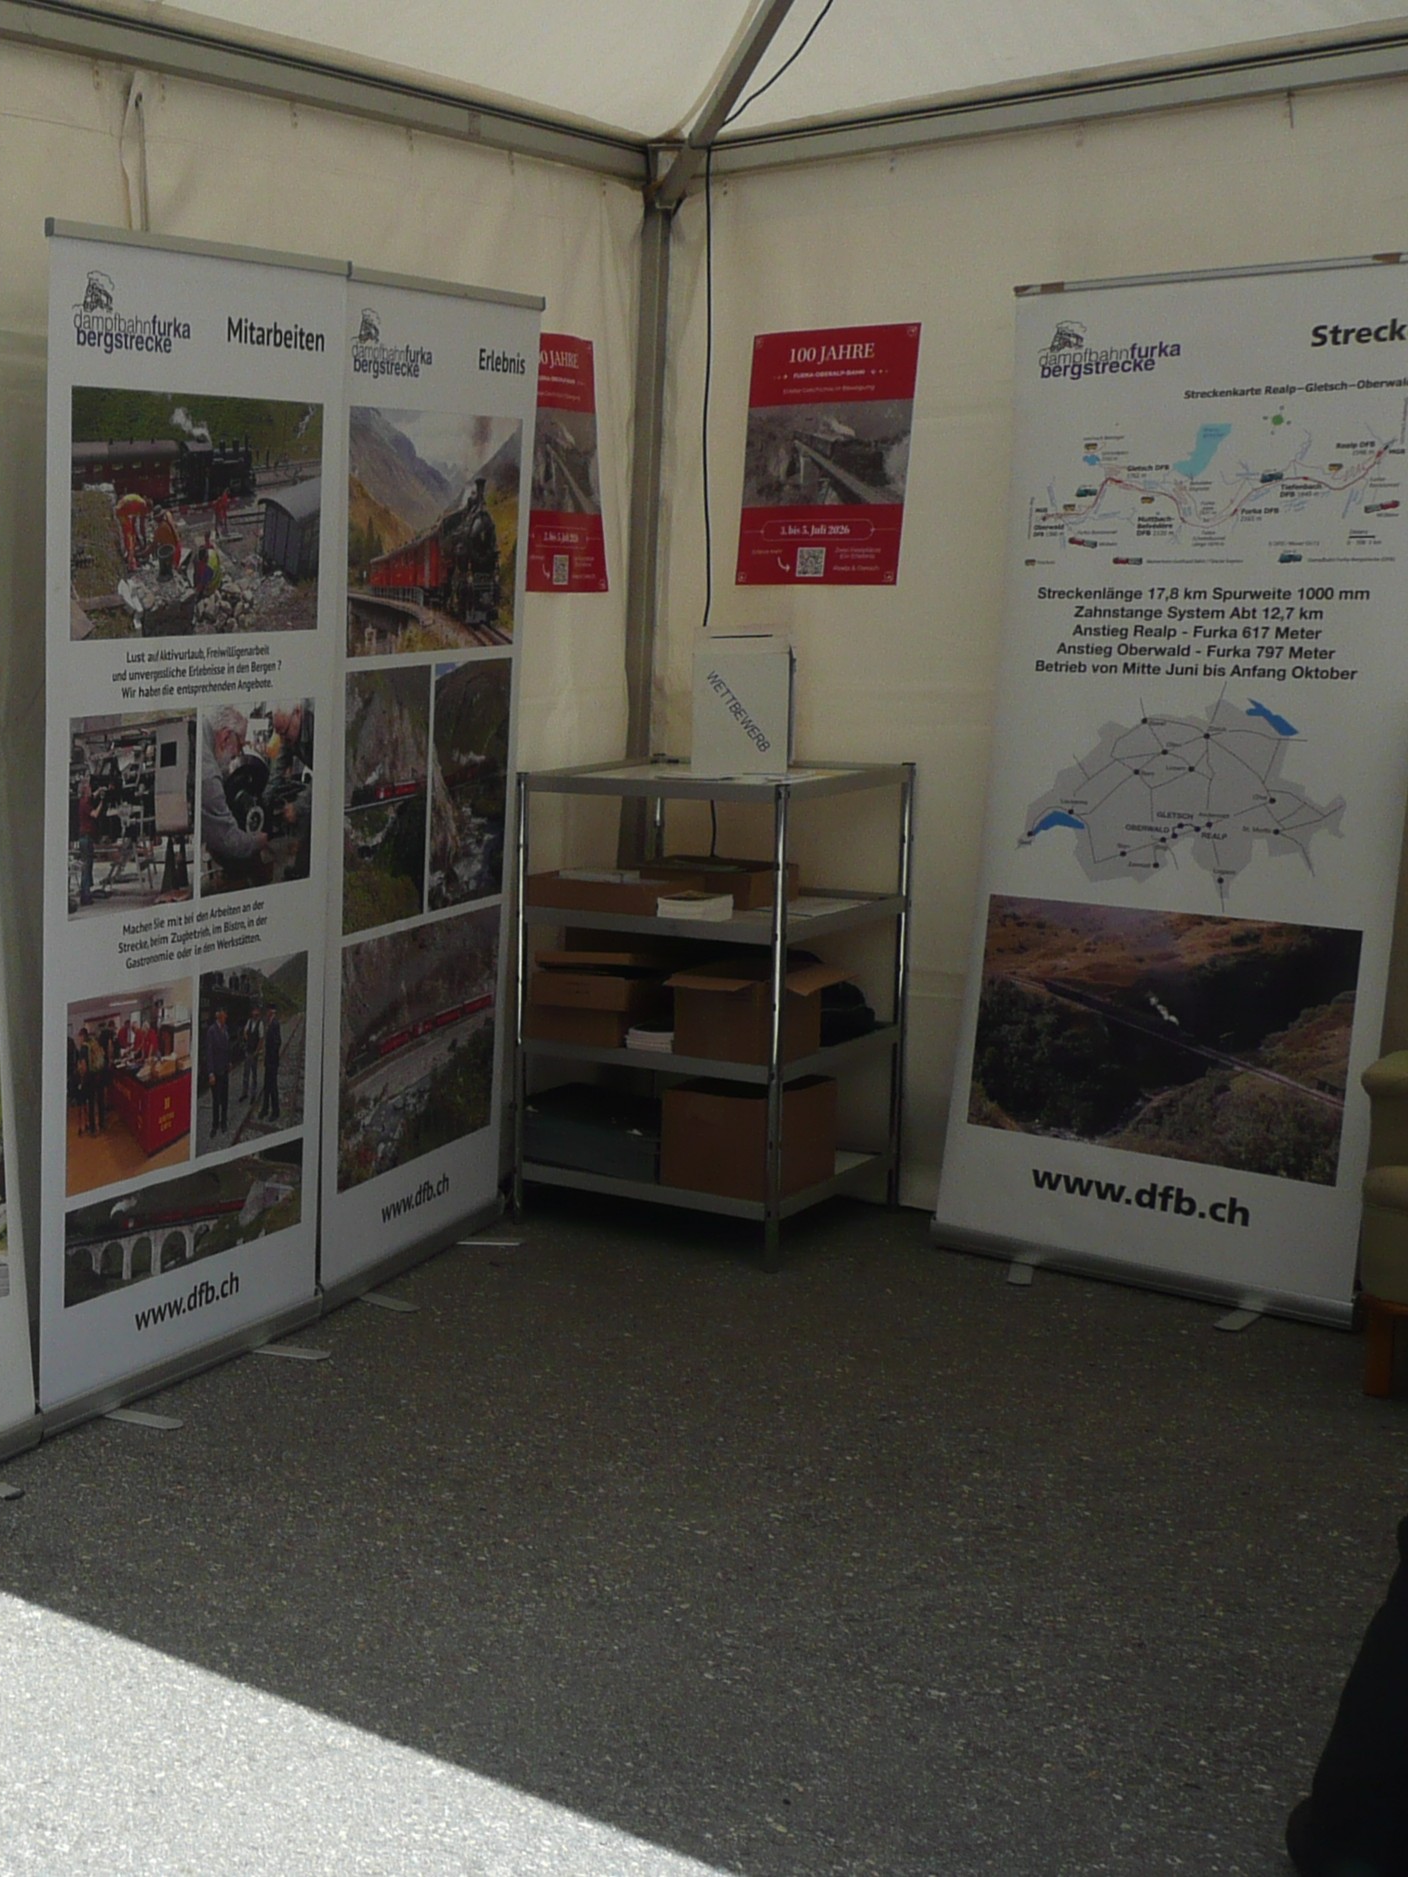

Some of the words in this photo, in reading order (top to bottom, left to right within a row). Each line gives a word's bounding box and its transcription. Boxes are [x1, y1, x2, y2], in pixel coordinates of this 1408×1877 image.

[73, 310, 191, 339] dampfbahnfurka
[227, 316, 325, 352] Mitarbeiten
[1311, 317, 1408, 348] Streck
[76, 326, 172, 353] bergstrecke
[479, 348, 526, 375] Erlebnis
[549, 350, 580, 369] JAHRE
[789, 347, 817, 364] 100
[818, 343, 875, 365] JAHRE
[1038, 341, 1181, 368] dampfbahnfurka
[353, 357, 420, 379] bergstrecke
[1040, 358, 1156, 380] bergstrecke
[1184, 386, 1262, 400] Streckenkarte
[1037, 587, 1142, 602] Streckenlänge
[1148, 588, 1179, 602] 17,8
[1184, 588, 1207, 600] km
[1212, 587, 1292, 603] Spurweite
[1297, 588, 1334, 600] 1000
[1339, 589, 1370, 601] mm
[1074, 606, 1162, 623] Zahnstange
[1167, 607, 1225, 623] System
[1229, 607, 1257, 620] Abt
[1262, 607, 1294, 623] 12,7
[1300, 608, 1323, 620] km
[1072, 625, 1128, 640] Anstieg
[1133, 626, 1177, 640] Realp
[1193, 626, 1238, 639] Furka
[1242, 627, 1270, 639] 617
[1275, 627, 1322, 640] Meter
[126, 652, 145, 663] Lust
[1057, 643, 1112, 658] Anstieg
[1117, 644, 1191, 657] Oberwald
[1207, 645, 1251, 659] Furka
[1256, 646, 1283, 659] 797
[1288, 647, 1336, 660] Meter
[112, 670, 126, 682] und
[129, 666, 186, 681] unvergessliche
[189, 665, 225, 677] Erlebnisse
[227, 663, 234, 674] in
[236, 662, 249, 673] den
[251, 661, 276, 674] Bergen
[1035, 660, 1087, 674] Betrieb
[1092, 664, 1118, 674] von
[1122, 662, 1161, 676] Mitte
[1166, 663, 1198, 677] Juni
[1203, 664, 1226, 677] bis
[1230, 665, 1287, 681] Anfang
[1292, 666, 1358, 681] Oktober
[121, 686, 136, 699] Wir
[138, 685, 160, 697] haben
[163, 684, 174, 695] die
[177, 680, 236, 696] entsprechenden
[707, 670, 771, 753] WETTBEWERB
[381, 1172, 450, 1224] www.dfb.ch
[1032, 1168, 1251, 1227] www.dfb.ch
[135, 1272, 240, 1332] www.dfb.ch
